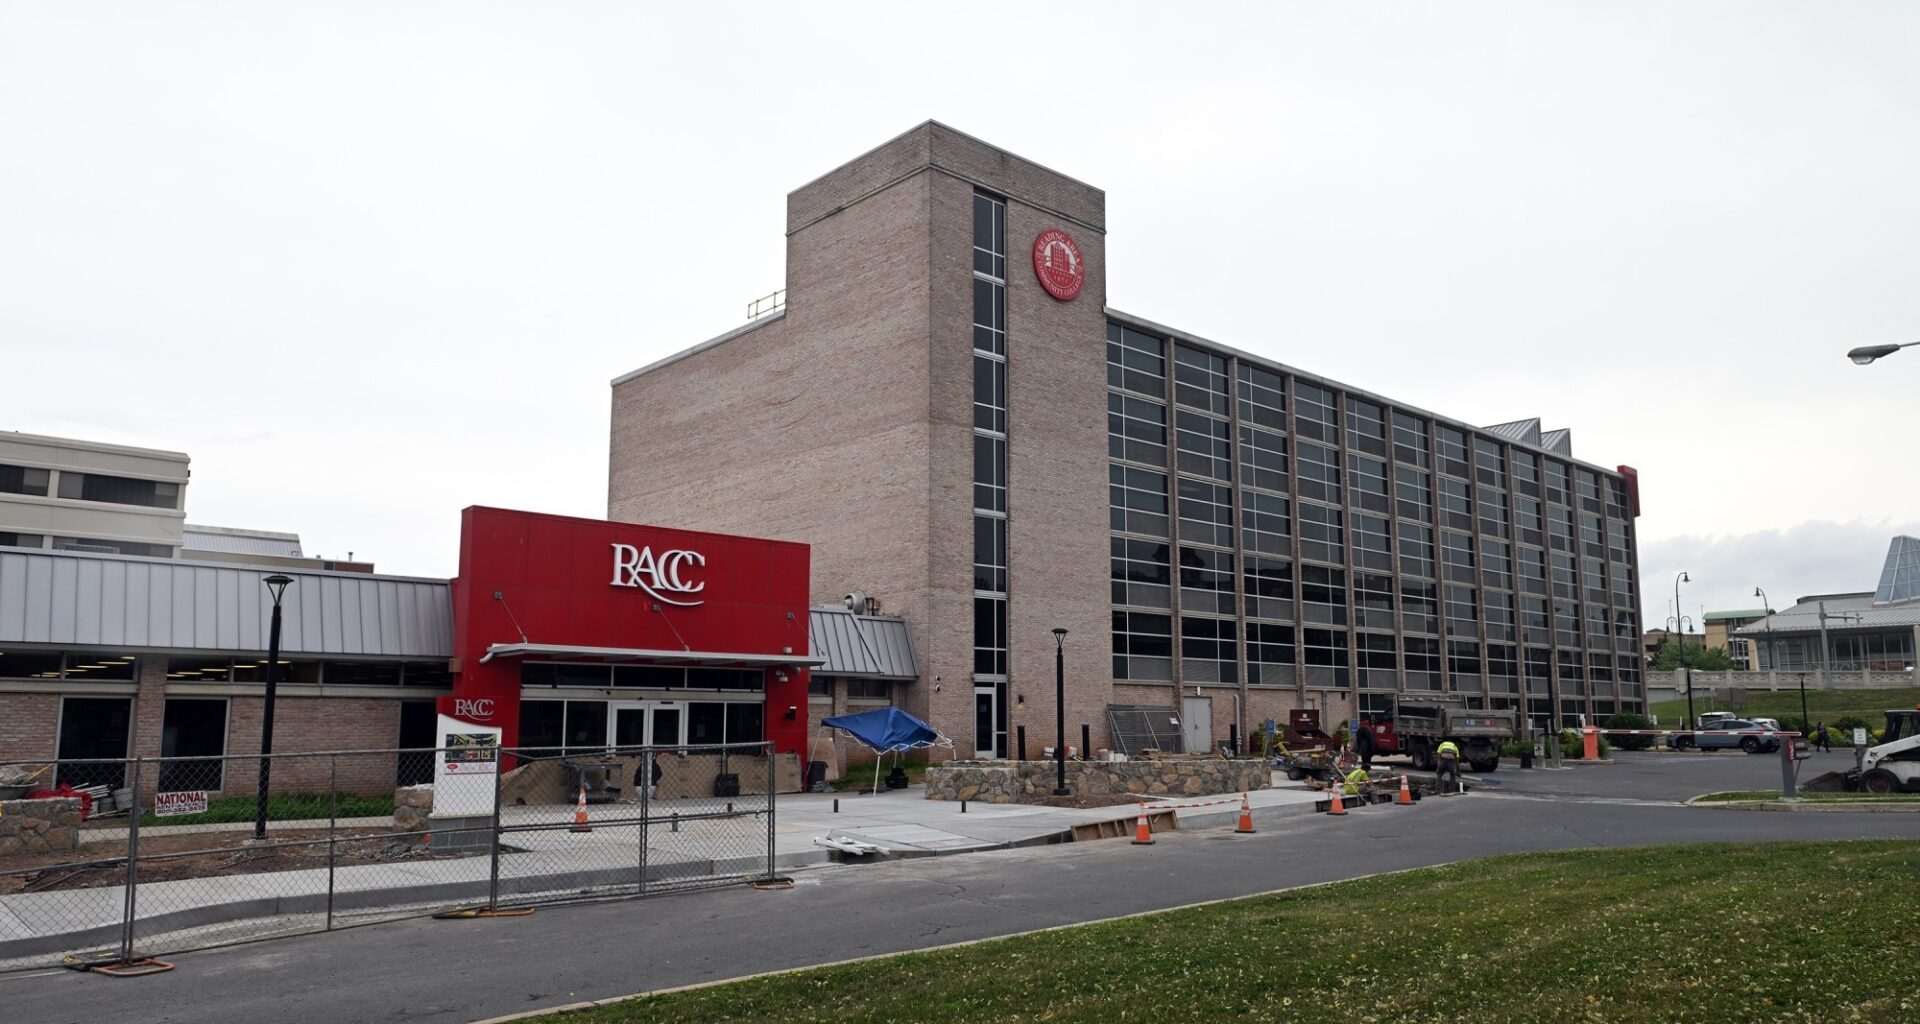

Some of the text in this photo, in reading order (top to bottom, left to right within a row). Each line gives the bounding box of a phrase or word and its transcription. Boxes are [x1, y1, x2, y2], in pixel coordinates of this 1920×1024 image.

[1038, 232, 1081, 263] READING AREA
[1038, 261, 1082, 296] COMMUNITY COLLEGE
[609, 543, 705, 606] RACC
[454, 699, 494, 721] RACC
[157, 792, 206, 805] NATIONAL
